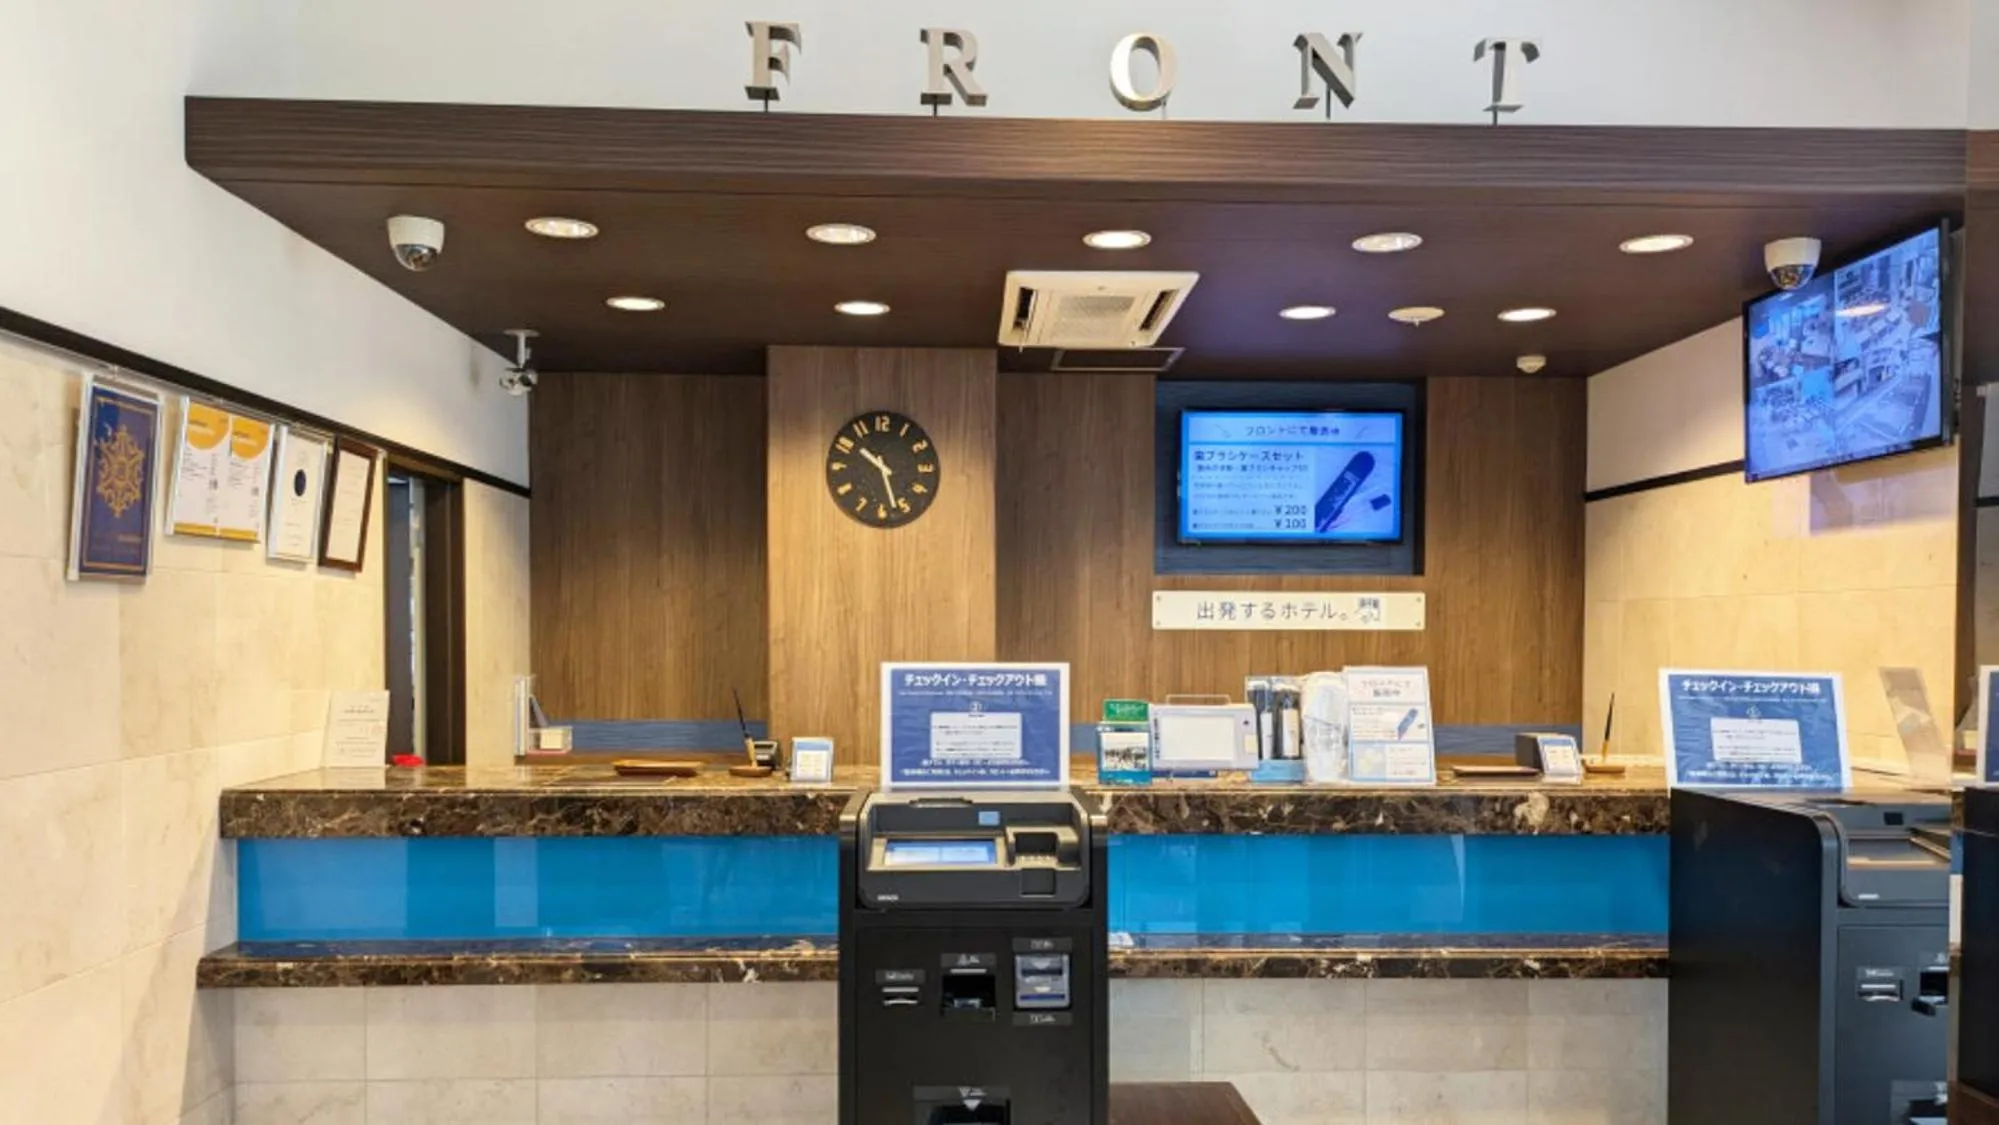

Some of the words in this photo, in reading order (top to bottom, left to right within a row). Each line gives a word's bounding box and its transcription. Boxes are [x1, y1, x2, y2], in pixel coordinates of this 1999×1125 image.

[744, 20, 1541, 112] FRONT
[853, 420, 868, 437] 11
[875, 416, 890, 432] 12
[899, 423, 909, 436] 1
[835, 437, 854, 453] 10
[912, 440, 928, 453] 2
[917, 464, 933, 473] 3
[855, 497, 868, 512] 7
[877, 503, 888, 520] 6
[897, 497, 911, 513] 5
[1196, 601, 1349, 621] 出発するホテル。
